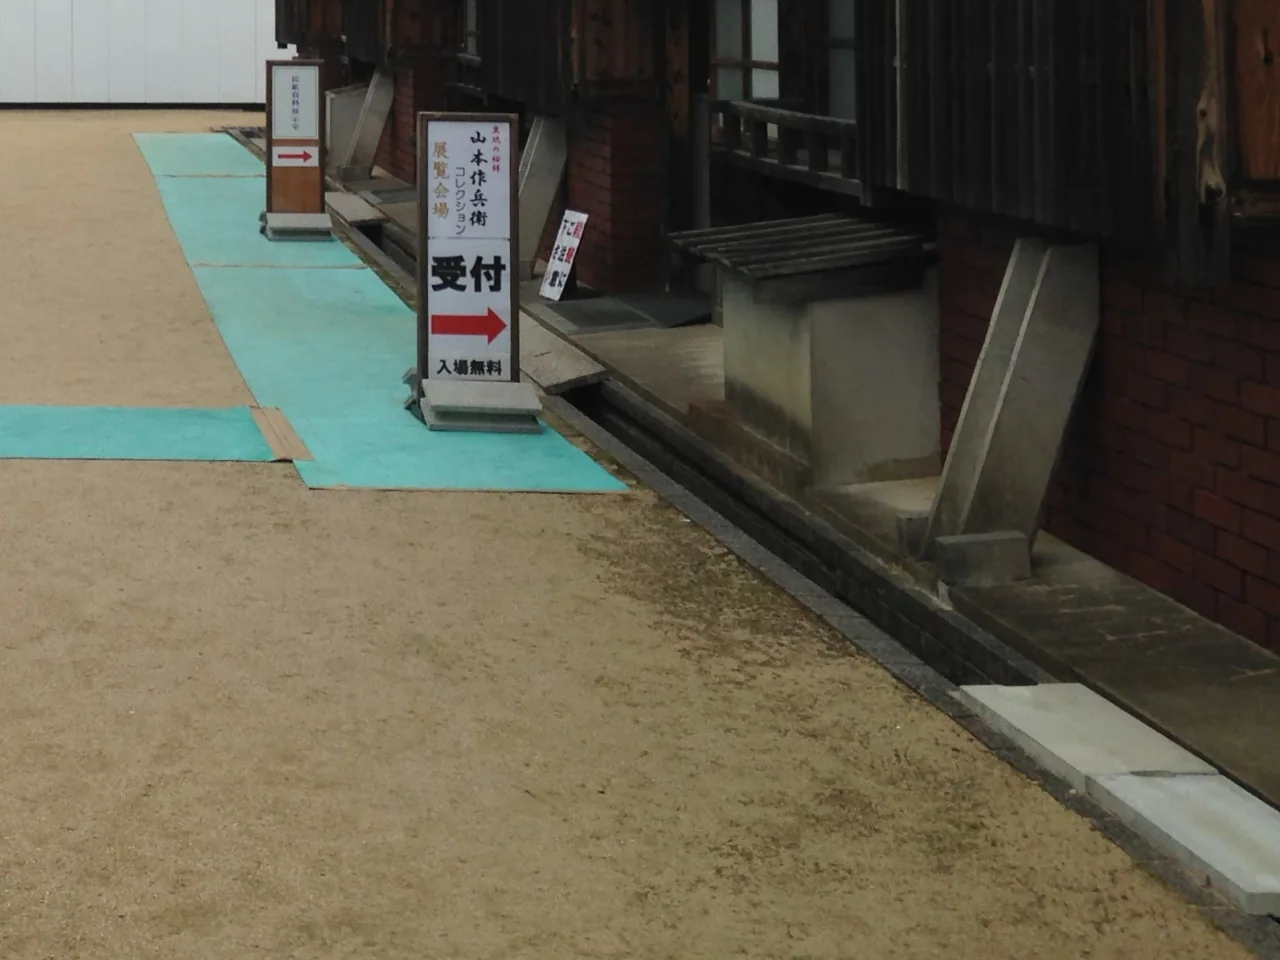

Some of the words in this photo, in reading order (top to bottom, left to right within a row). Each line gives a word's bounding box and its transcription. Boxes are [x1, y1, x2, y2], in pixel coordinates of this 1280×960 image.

[432, 141, 450, 220] 展覧会場
[455, 166, 467, 236] コレクション
[469, 130, 488, 227] 山本作兵衛
[431, 255, 506, 293] 受付
[436, 359, 502, 376] 入場無料
